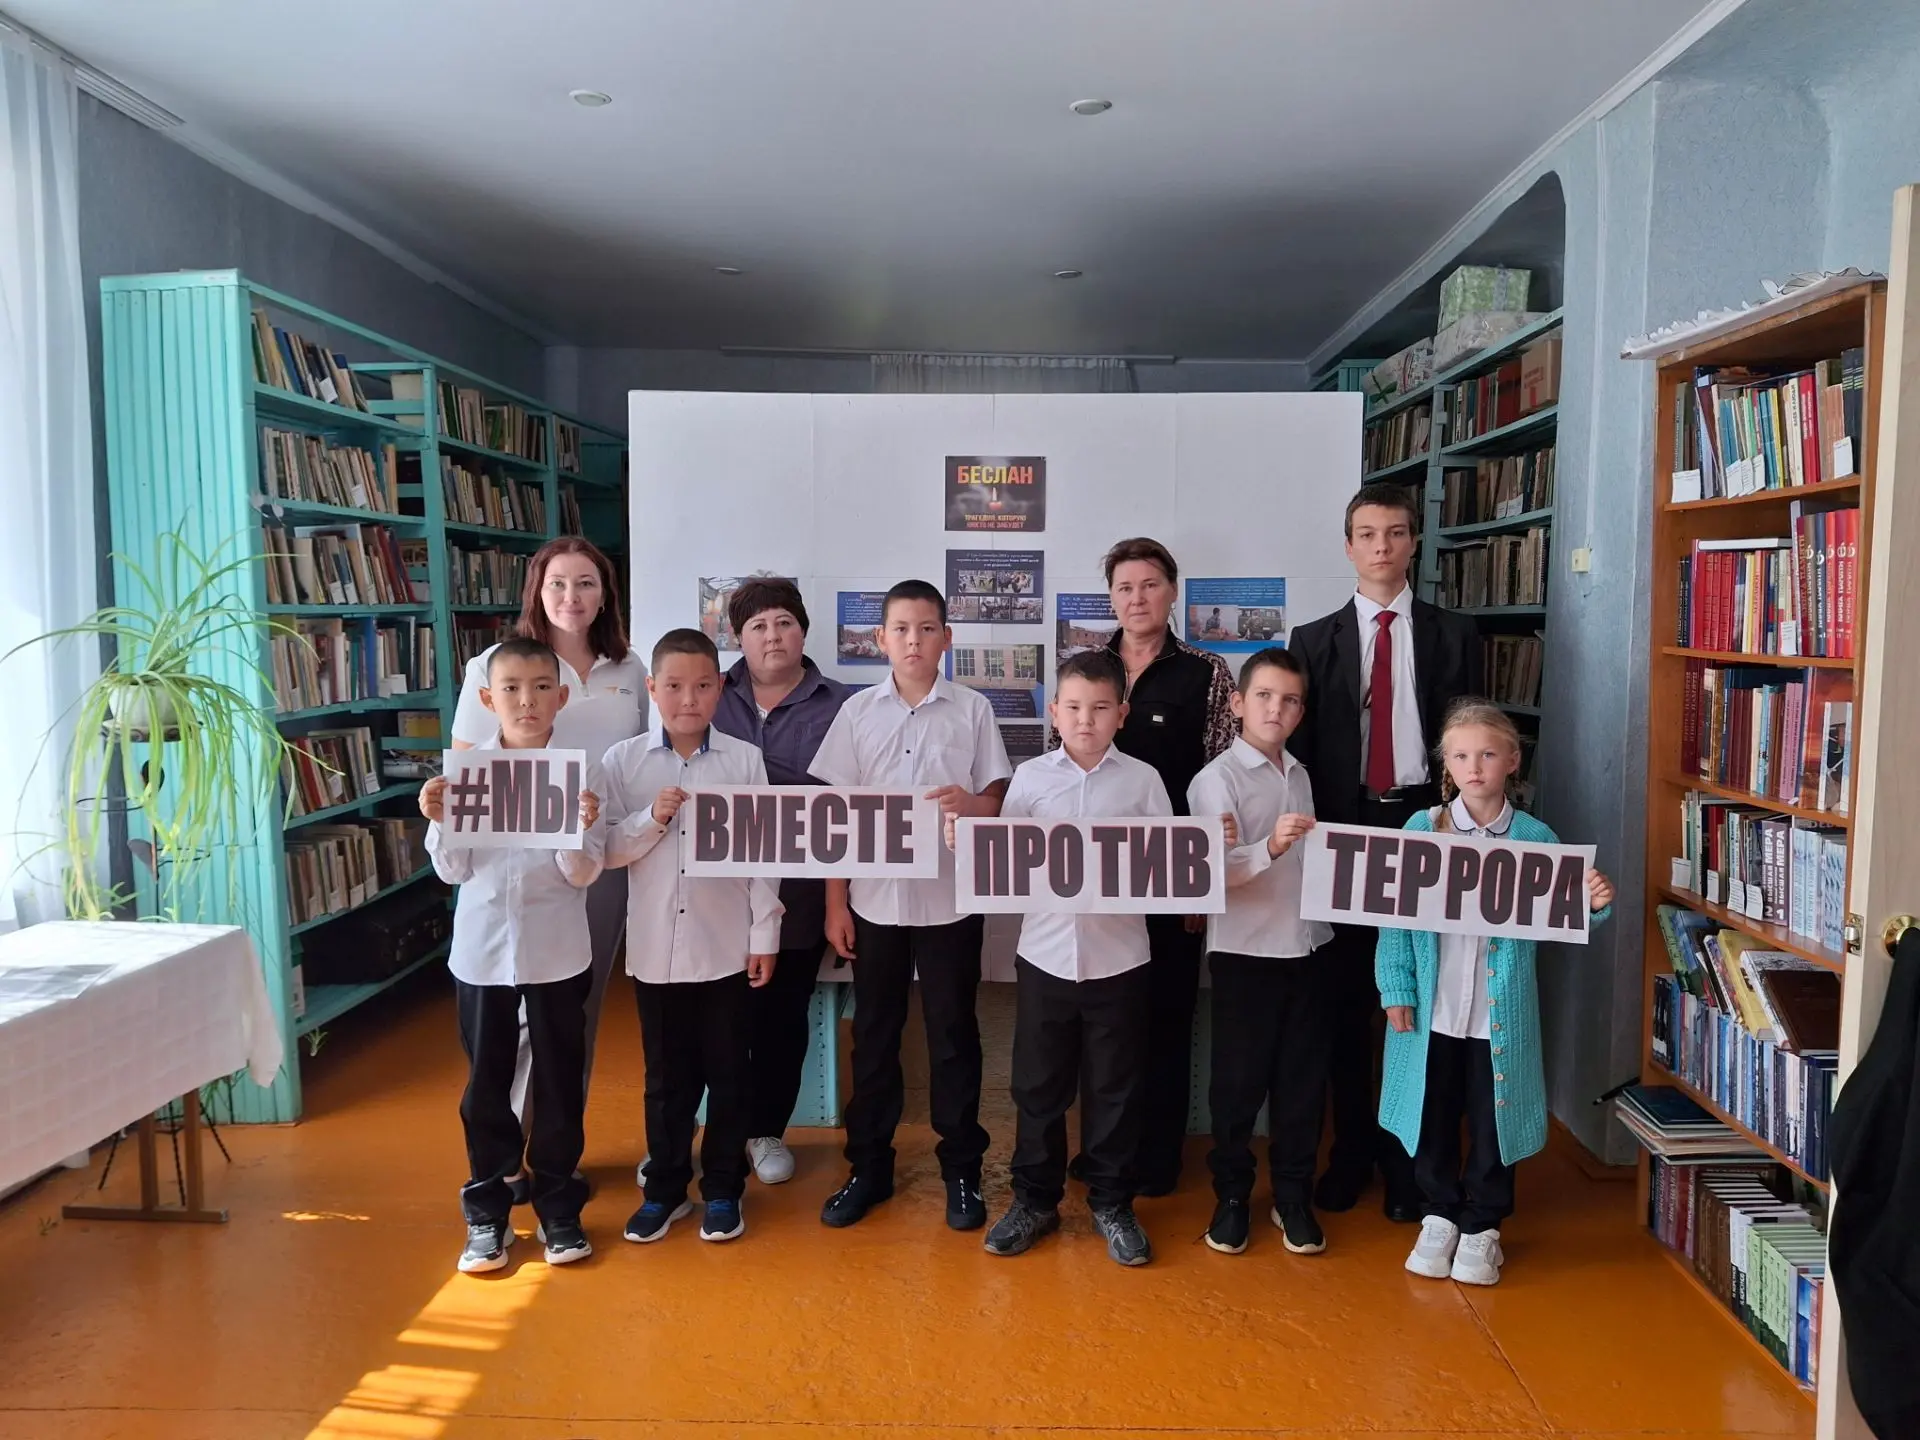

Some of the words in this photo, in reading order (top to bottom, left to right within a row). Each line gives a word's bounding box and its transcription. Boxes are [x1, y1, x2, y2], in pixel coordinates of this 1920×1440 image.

[957, 465, 1033, 485] БЕСЛАН
[450, 759, 580, 834] #МЫ
[694, 793, 914, 864] ВМЕСТЕ
[1764, 828, 1773, 863] МЕРА
[973, 824, 1211, 898] ПРОТИВ
[1776, 830, 1785, 867] МЕРА
[1326, 832, 1585, 931] ТЕРРОРА
[1766, 865, 1774, 902] ВЫСШАЯ
[1764, 905, 1773, 917] 2
